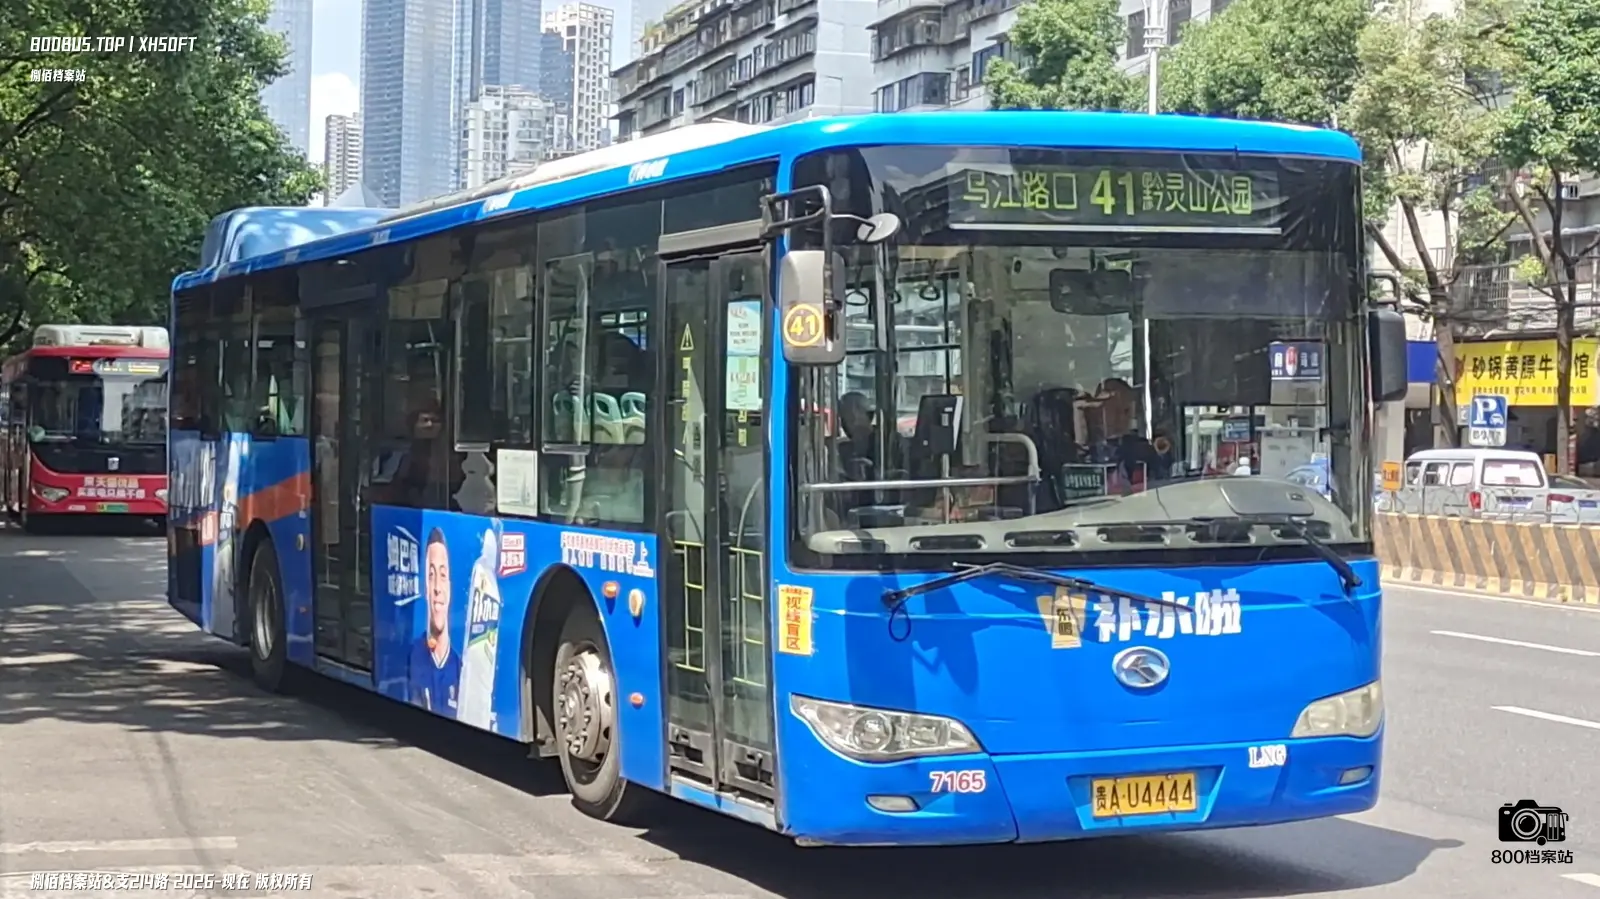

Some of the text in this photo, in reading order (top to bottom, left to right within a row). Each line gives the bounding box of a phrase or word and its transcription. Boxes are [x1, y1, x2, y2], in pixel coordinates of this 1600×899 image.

[963, 170, 1252, 215] 乌江路口 41 黔灵山公园
[790, 315, 816, 336] 41
[1472, 353, 1589, 380] 砂锅黄膘牛馆
[1473, 398, 1497, 425] P
[786, 596, 802, 651] 视线盲区
[1093, 588, 1242, 643] 补水啦
[1248, 744, 1287, 768] LNG
[930, 770, 986, 793] 7165
